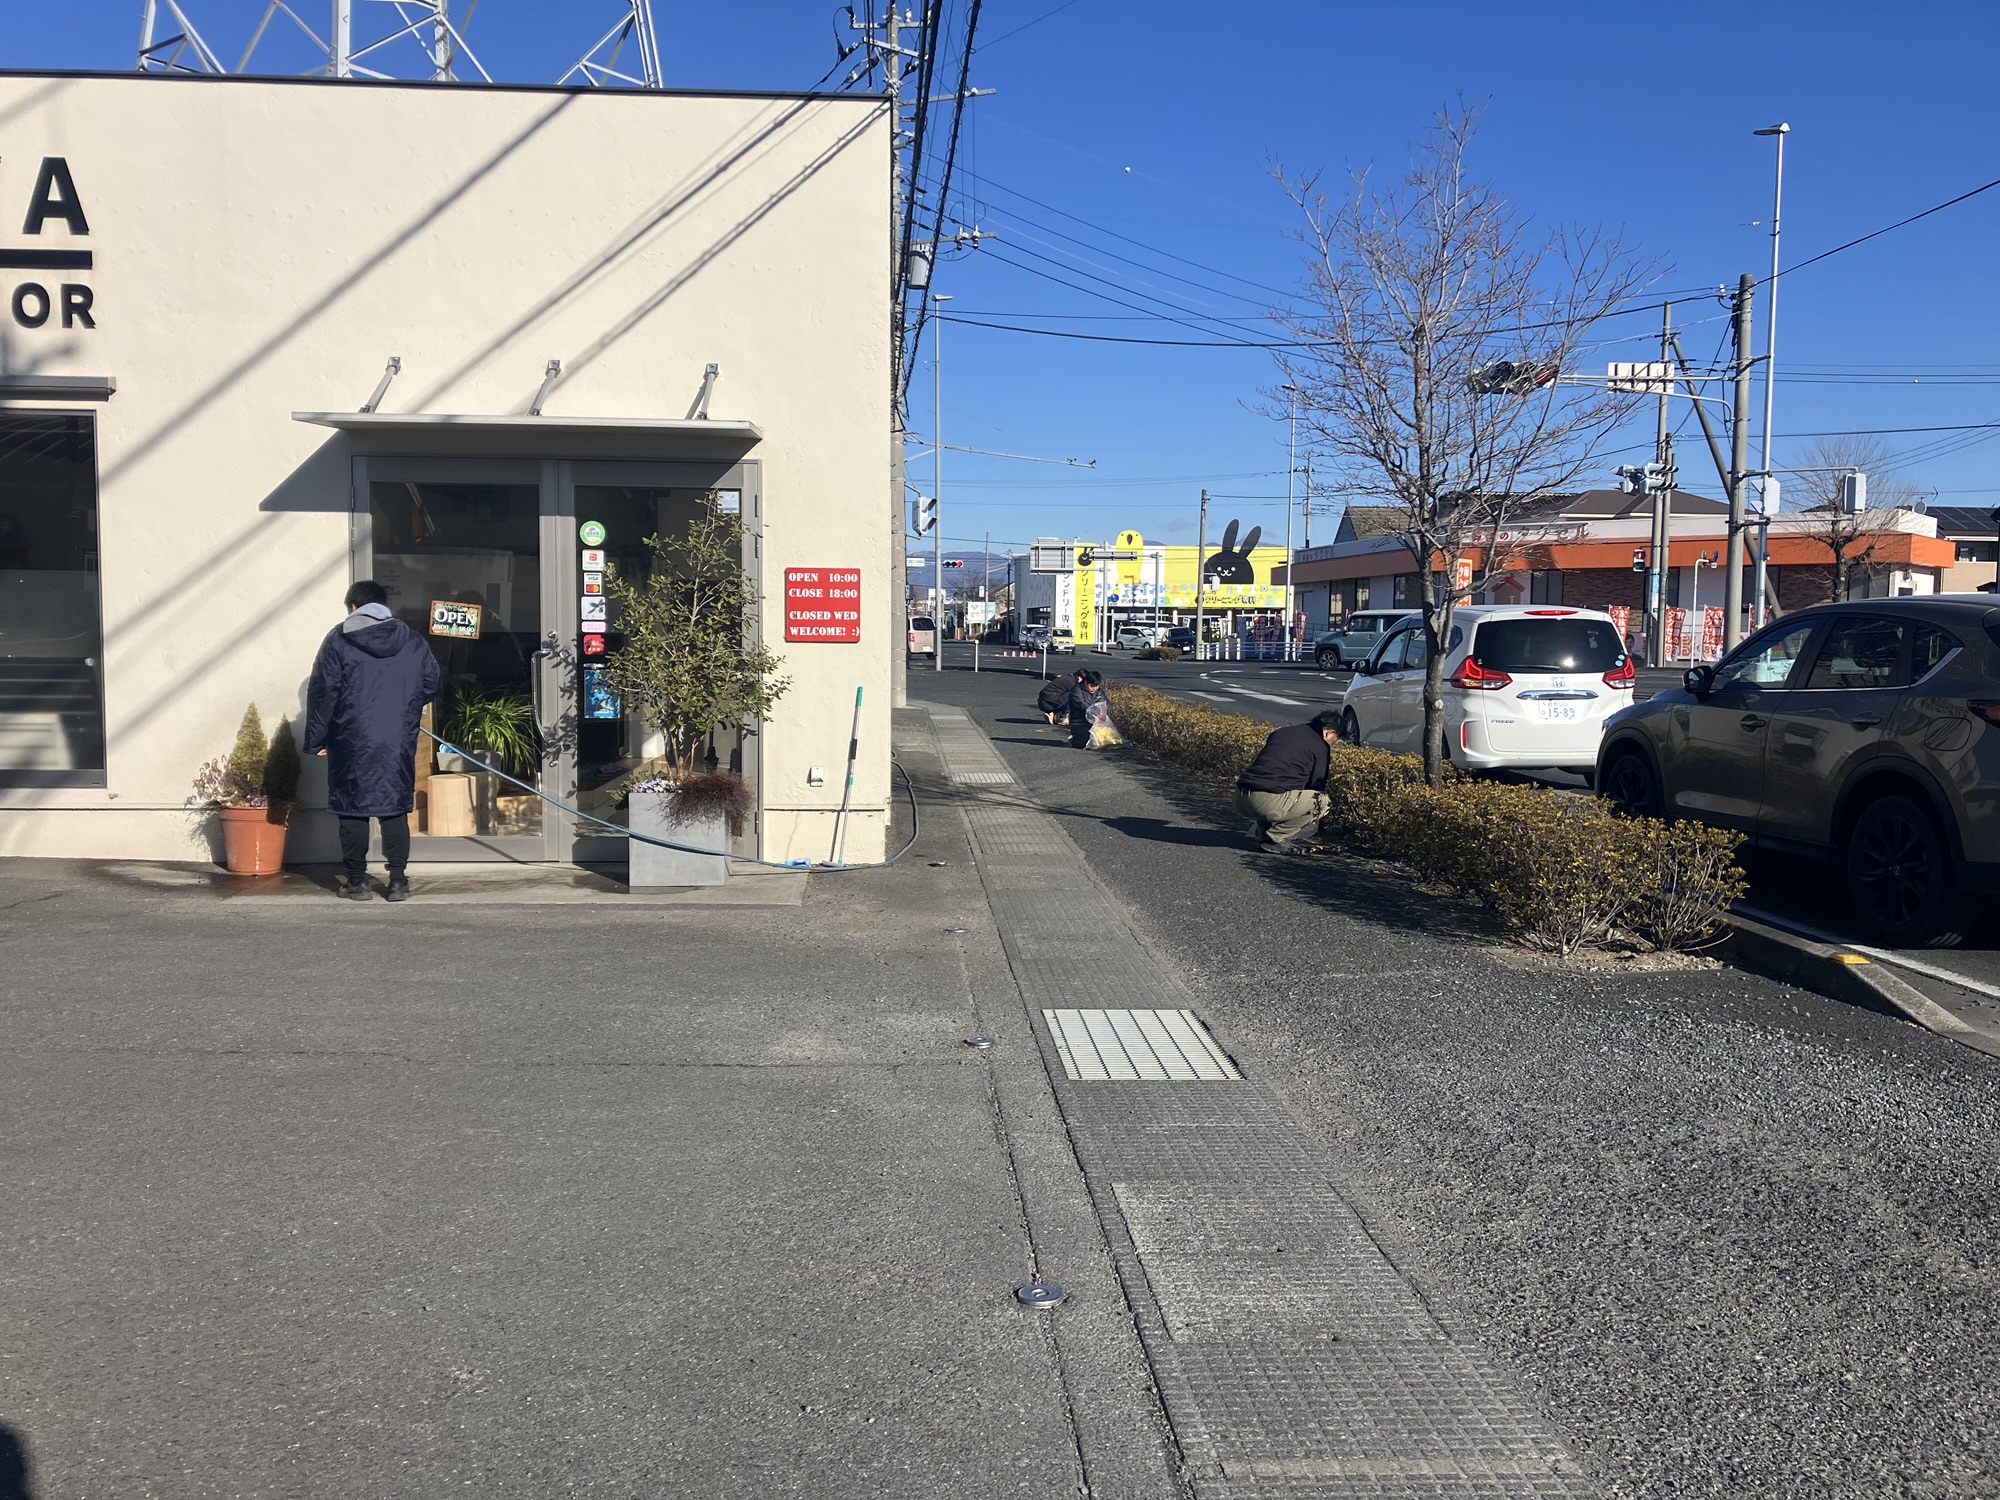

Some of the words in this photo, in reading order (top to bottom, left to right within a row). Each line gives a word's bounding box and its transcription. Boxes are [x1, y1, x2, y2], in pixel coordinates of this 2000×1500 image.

[0, 156, 90, 235] A
[11, 281, 96, 330] OR
[788, 572, 819, 582] OPEN
[829, 573, 858, 583] 10:00
[788, 588, 823, 598] CLOSE
[829, 589, 858, 598] 18:00
[434, 608, 476, 626] OPEN
[789, 610, 831, 620] CLOSED
[833, 611, 858, 620] WED
[789, 626, 847, 636] WELCOME!
[1548, 707, 1575, 718] 15-89
